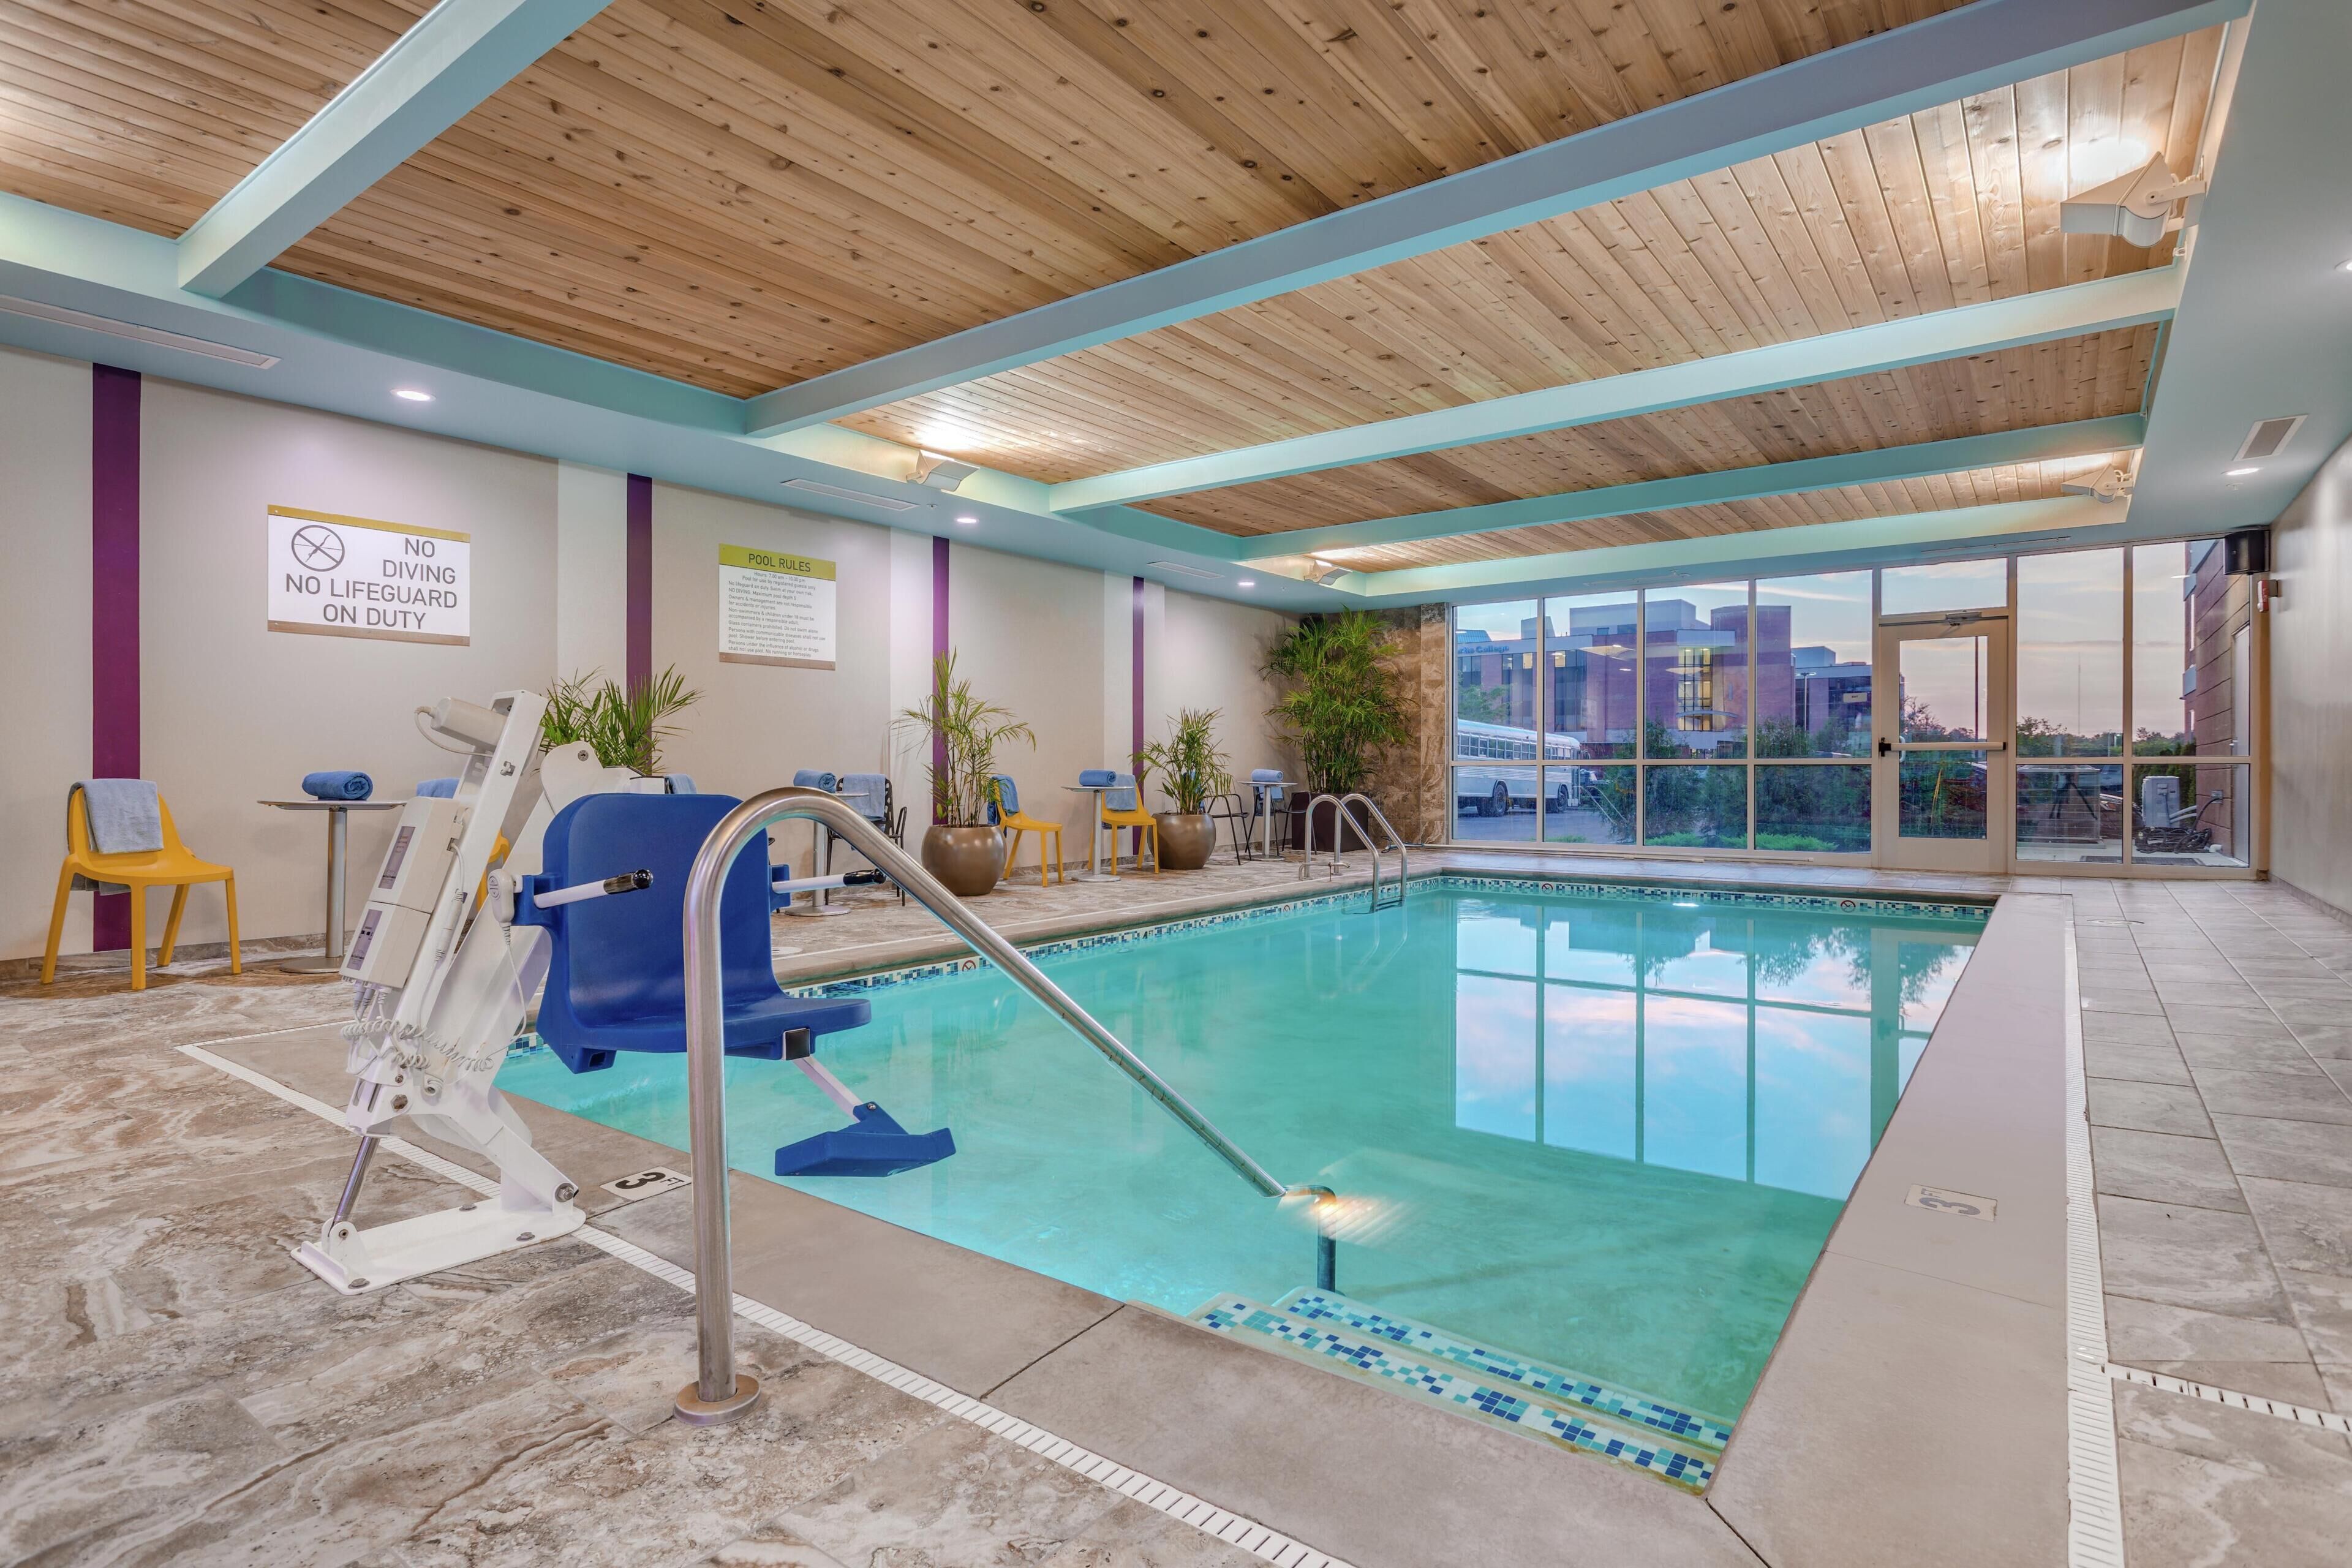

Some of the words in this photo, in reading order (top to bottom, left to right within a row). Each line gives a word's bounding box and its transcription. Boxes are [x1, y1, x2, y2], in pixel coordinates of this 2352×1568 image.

[405, 538, 435, 558] NO
[383, 559, 455, 584] DIVING
[748, 554, 775, 567] POOL
[779, 558, 810, 572] RULES
[286, 573, 320, 594] NO
[331, 578, 457, 608] LIFEGUARD
[323, 604, 356, 624] ON
[366, 608, 426, 629] DUTY
[616, 1172, 666, 1189] 3
[660, 1177, 685, 1186] FT
[1919, 1197, 1980, 1215] 3
